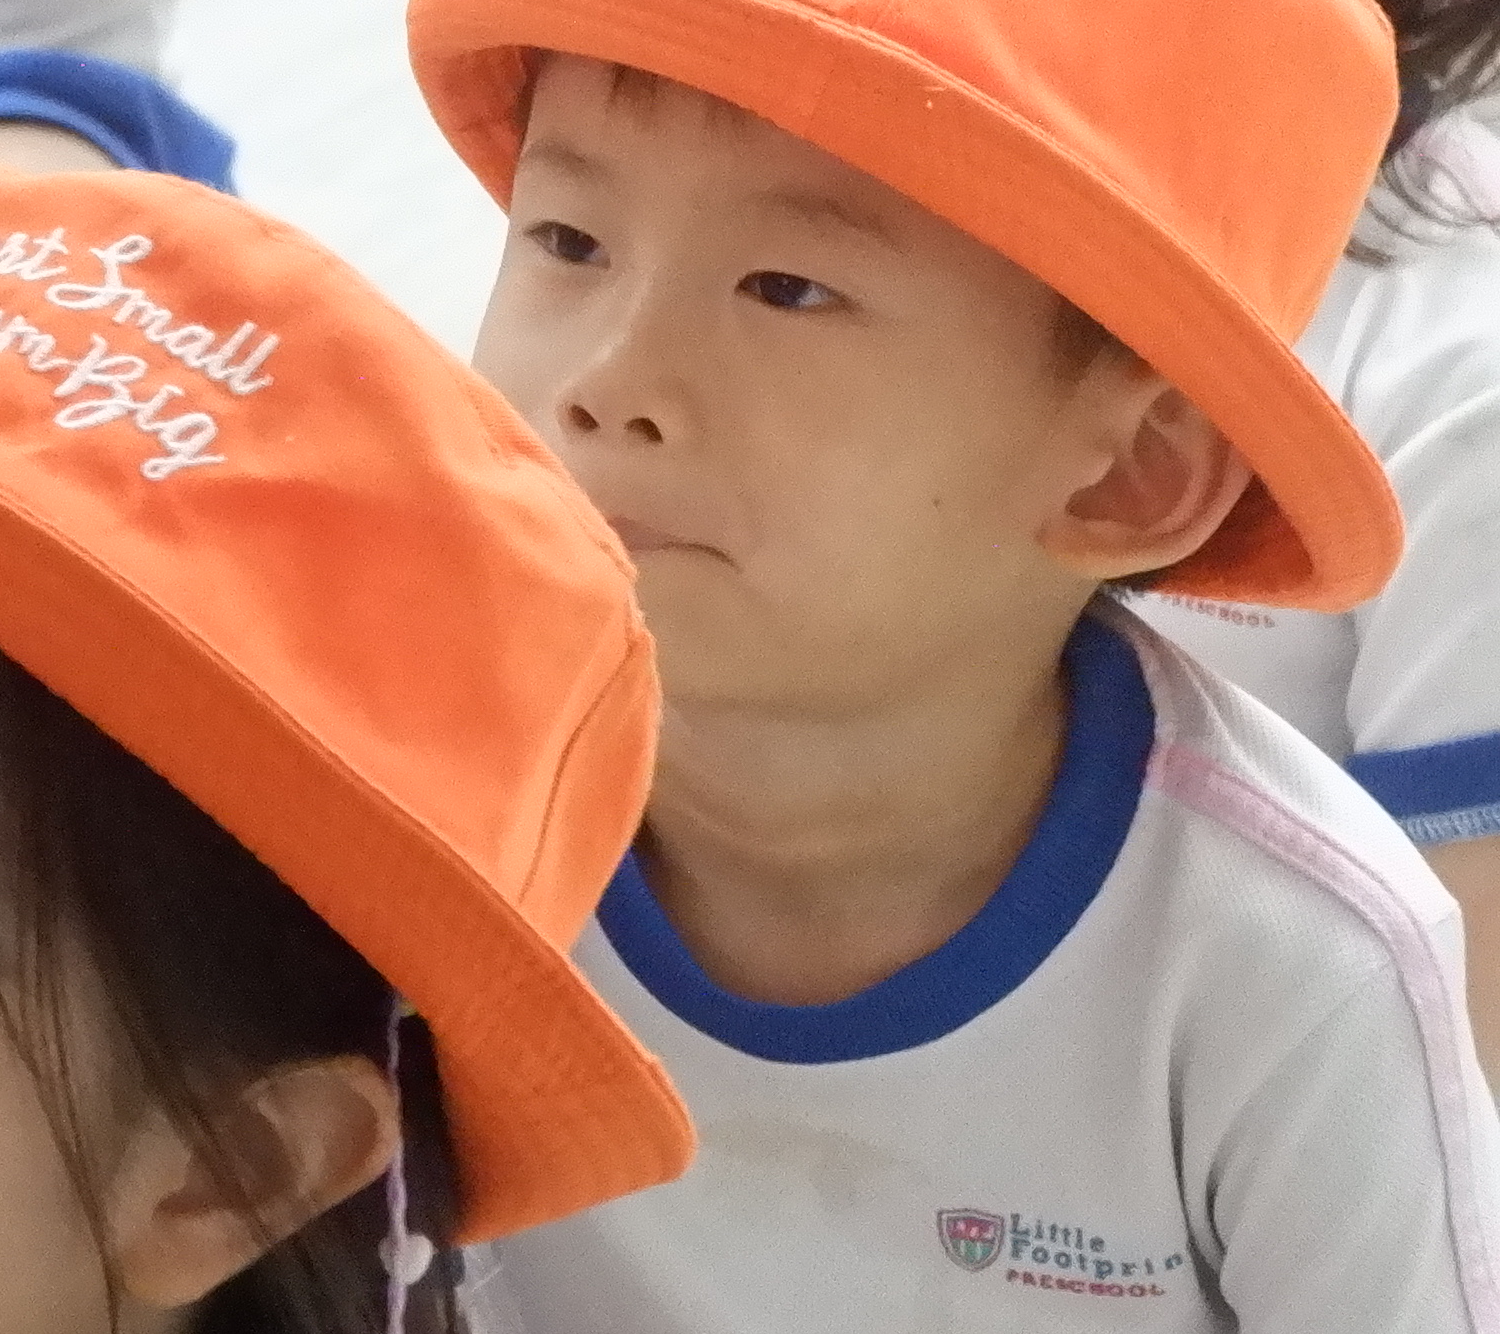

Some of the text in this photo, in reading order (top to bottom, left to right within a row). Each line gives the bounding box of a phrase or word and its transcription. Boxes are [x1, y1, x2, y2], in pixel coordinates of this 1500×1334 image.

[45, 234, 280, 395] Small
[53, 333, 228, 481] Big
[1010, 1213, 1105, 1253] Little
[1005, 1268, 1166, 1298] PRESCHOOL
